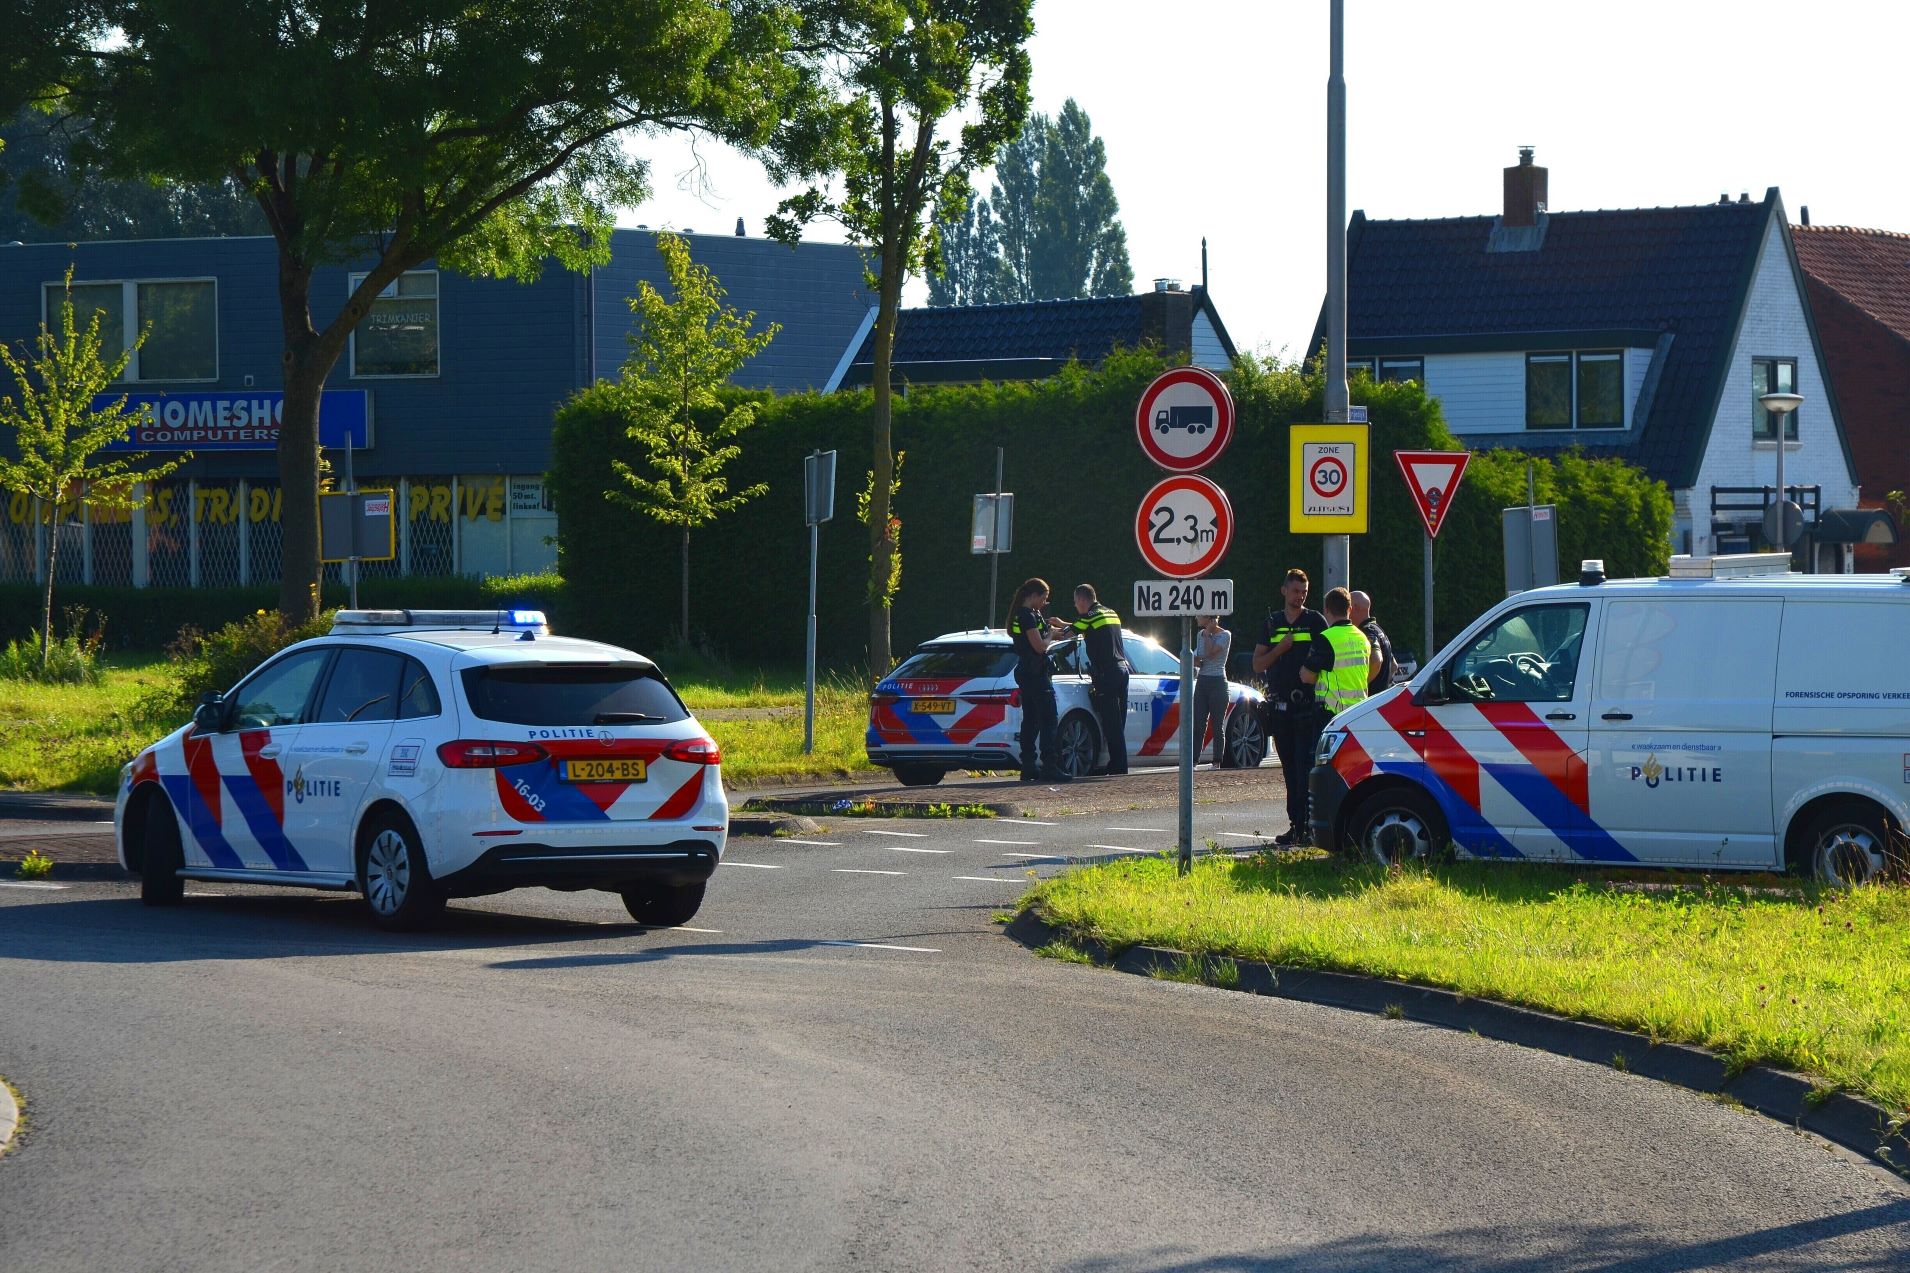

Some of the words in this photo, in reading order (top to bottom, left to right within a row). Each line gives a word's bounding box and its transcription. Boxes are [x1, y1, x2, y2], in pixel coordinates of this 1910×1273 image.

[141, 428, 281, 442] COMPUTERS
[1318, 446, 1340, 454] ZONE
[1317, 469, 1341, 486] 30
[409, 476, 505, 524] PRIVÉ
[1137, 585, 1162, 611] Na
[1168, 584, 1205, 611] 240
[1211, 590, 1228, 610] m
[882, 682, 914, 691] POLITIE
[1785, 691, 1835, 699] FORENSISCHE
[1837, 692, 1880, 700] OPSPORING
[913, 701, 951, 711] X-549-VT
[528, 728, 595, 739] POLITIE
[1681, 742, 1716, 751] dienstbaar
[572, 762, 640, 778] L-204-BS
[1631, 765, 1722, 789] POLITIE
[287, 779, 341, 804] POLITIE
[514, 778, 546, 812] 16-03
